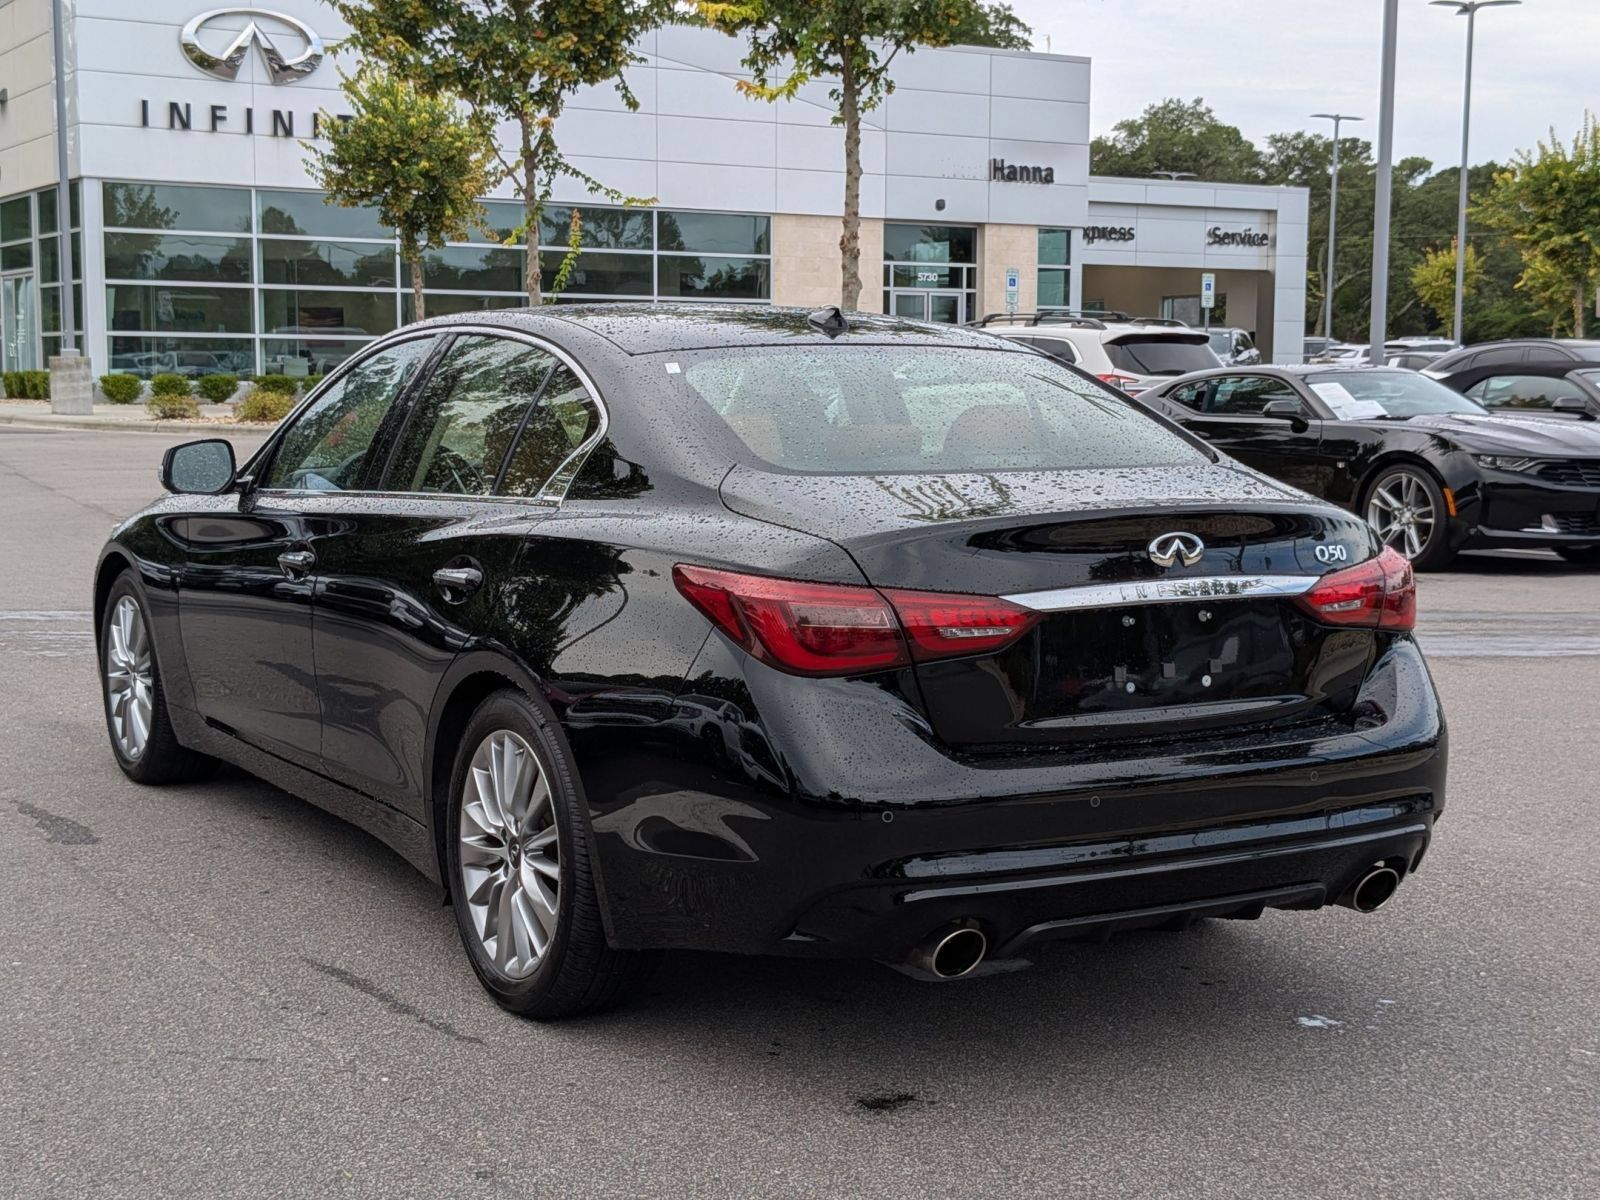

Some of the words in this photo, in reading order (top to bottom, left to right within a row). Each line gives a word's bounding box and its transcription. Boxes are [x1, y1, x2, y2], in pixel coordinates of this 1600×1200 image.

[141, 99, 354, 139] INFINIT
[991, 158, 1054, 184] Hanna
[1083, 226, 1135, 245] xpress
[1207, 226, 1269, 247] Service
[917, 272, 938, 282] 5730
[1315, 544, 1347, 565] Q50
